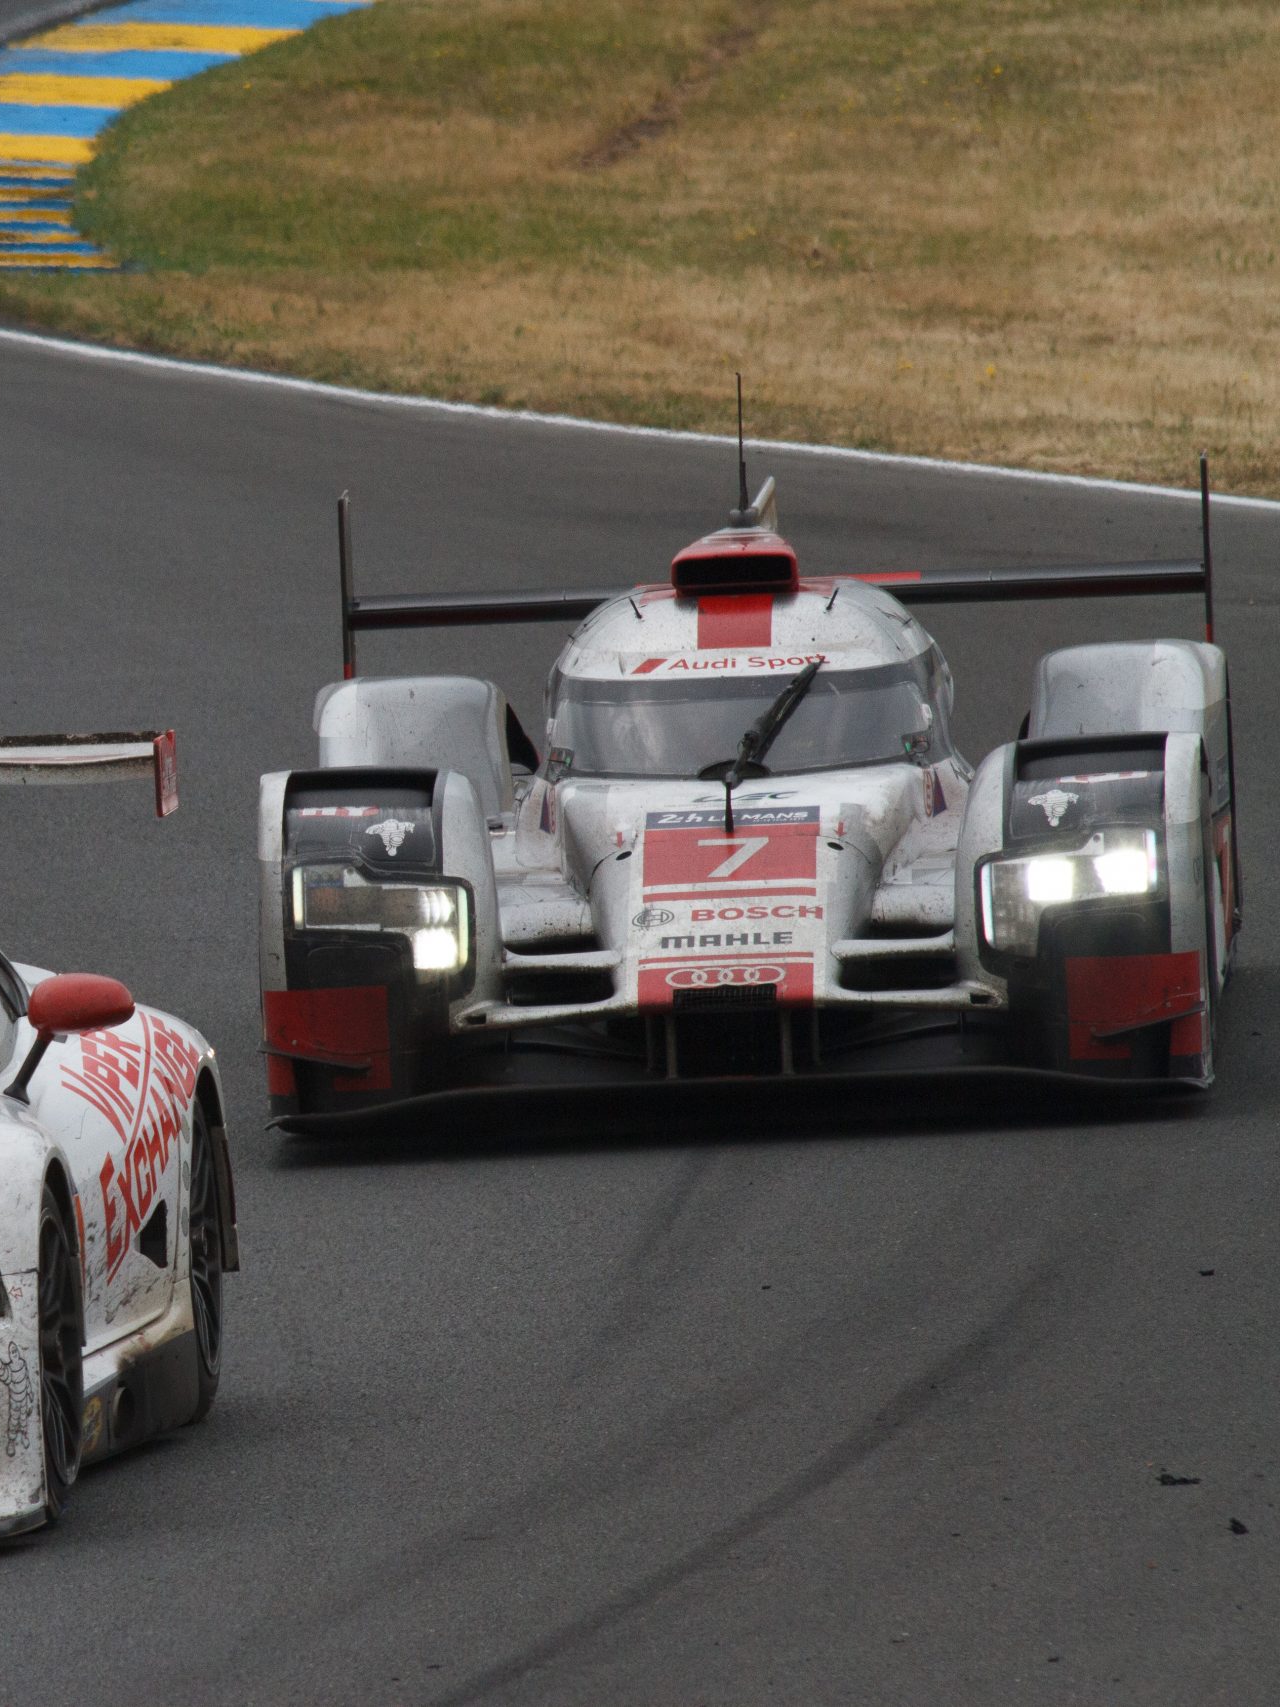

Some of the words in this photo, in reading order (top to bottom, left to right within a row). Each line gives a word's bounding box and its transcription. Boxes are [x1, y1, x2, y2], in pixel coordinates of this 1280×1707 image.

[668, 657, 737, 671] Audi
[748, 652, 831, 669] Sport
[741, 811, 809, 821] MANS
[697, 836, 770, 878] 7
[691, 905, 824, 922] BOSCH
[661, 931, 793, 949] MAHLE
[59, 1026, 142, 1144] VIPER
[99, 1011, 201, 1274] EXCHANGE
